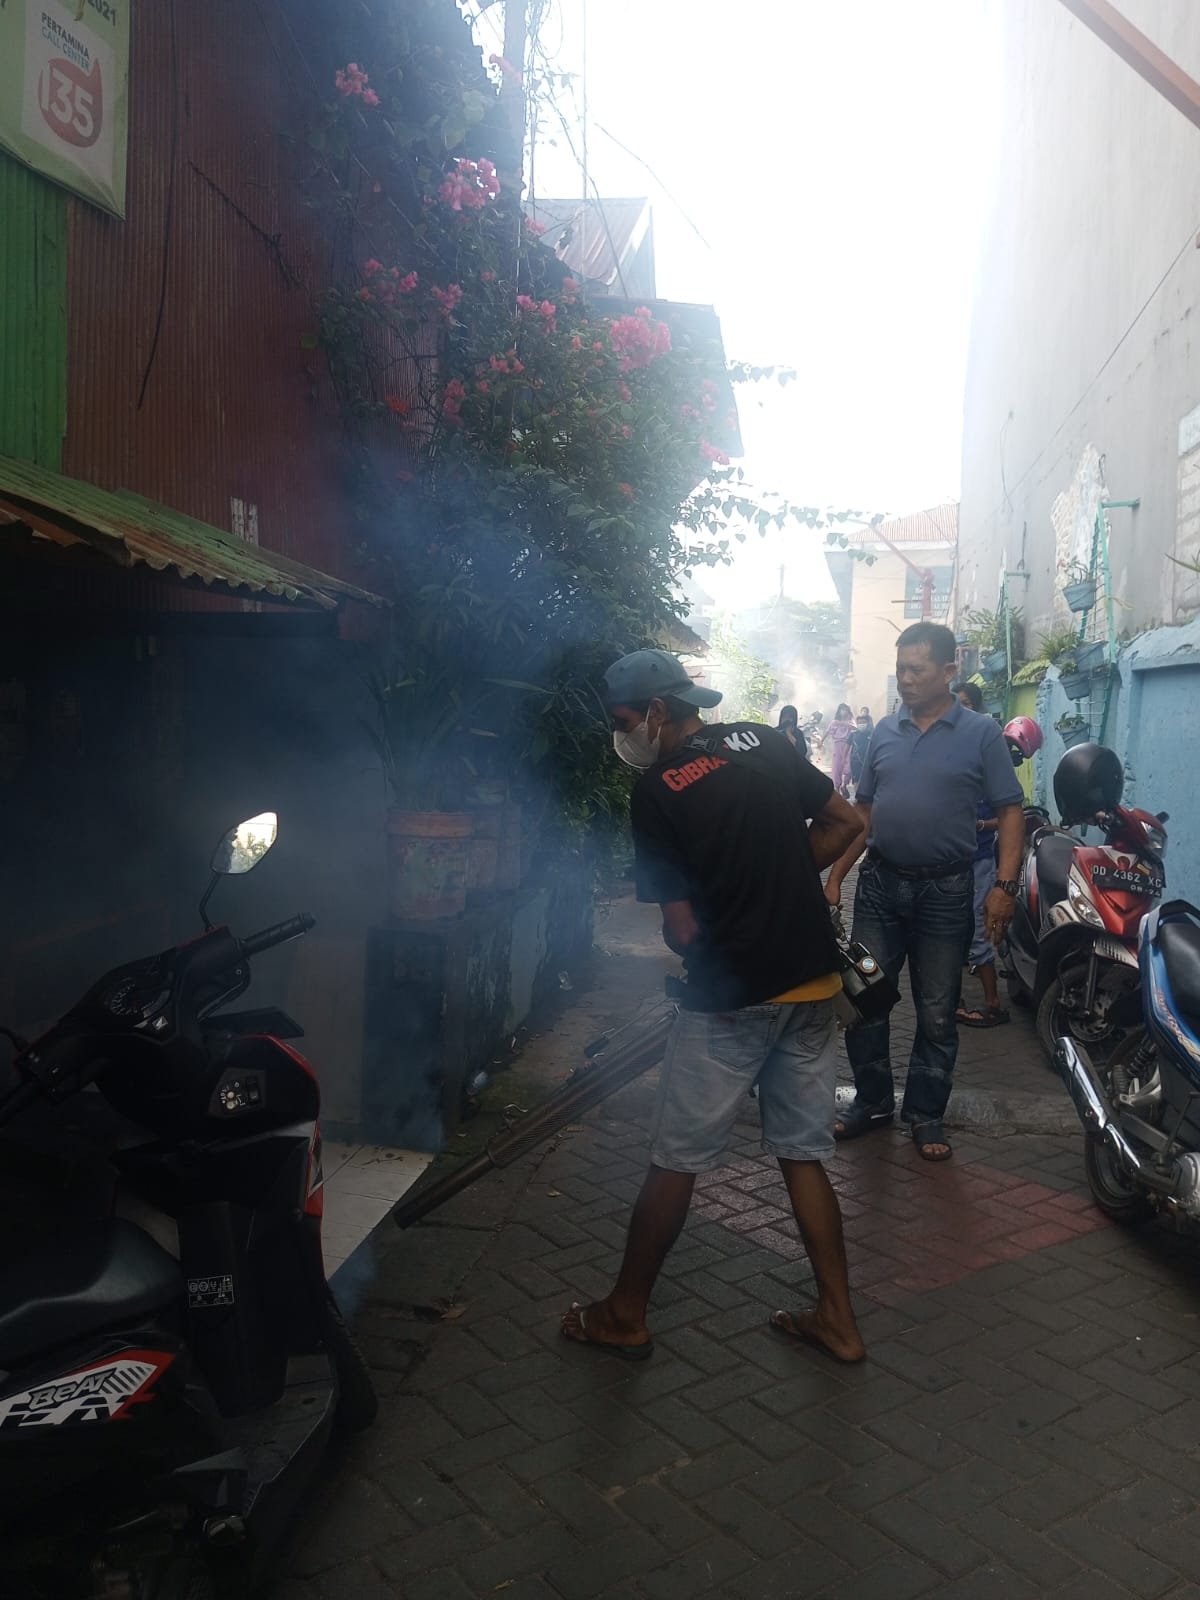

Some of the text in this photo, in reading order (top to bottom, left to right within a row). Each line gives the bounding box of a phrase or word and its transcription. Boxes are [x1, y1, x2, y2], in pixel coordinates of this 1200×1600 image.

[41, 12, 90, 59] PERTAMINA
[41, 27, 90, 71] CALL CENTER
[40, 64, 94, 138] 135
[1093, 865, 1106, 876] DD
[1113, 870, 1141, 883] 4362
